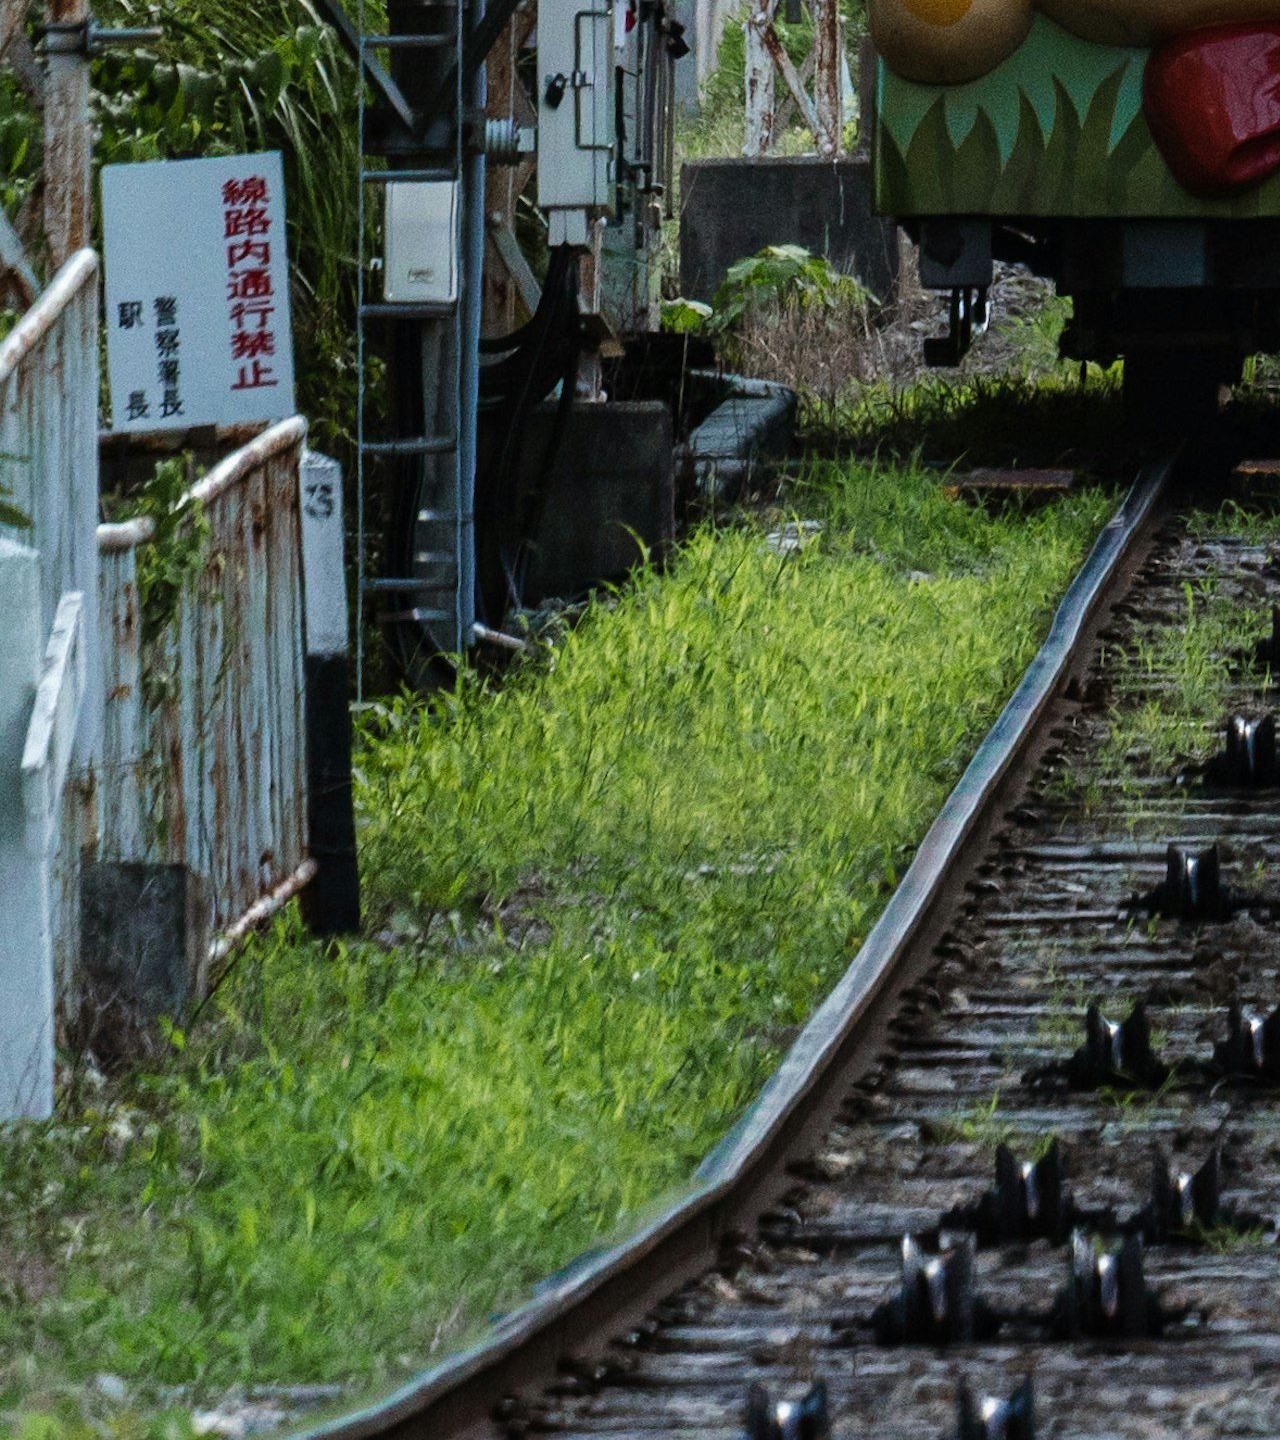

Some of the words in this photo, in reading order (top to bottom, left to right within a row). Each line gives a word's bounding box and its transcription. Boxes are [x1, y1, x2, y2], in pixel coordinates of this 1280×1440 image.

[153, 295, 185, 419] 警察署長
[221, 175, 279, 391] 線路内通行禁止
